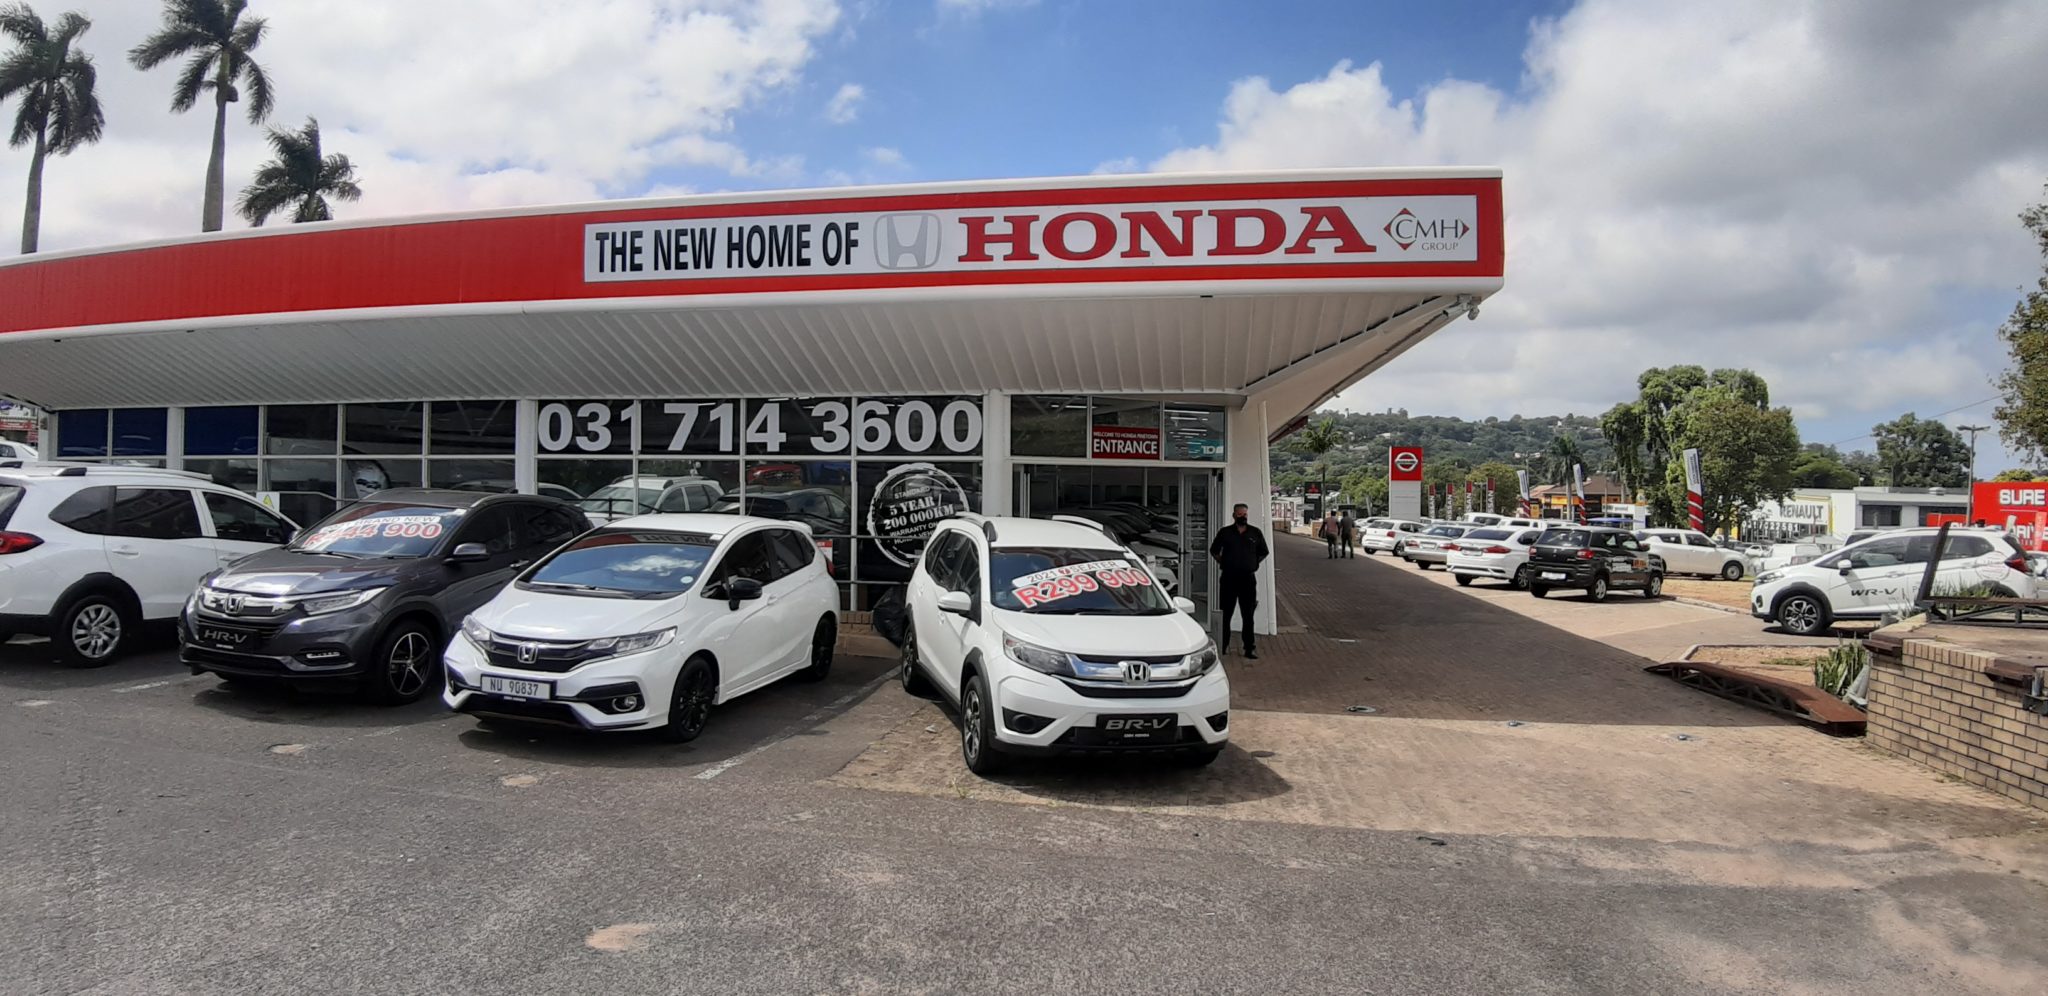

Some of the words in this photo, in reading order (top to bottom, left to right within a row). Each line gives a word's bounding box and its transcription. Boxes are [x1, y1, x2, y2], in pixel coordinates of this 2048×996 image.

[957, 206, 1377, 262] HONDA
[1396, 219, 1458, 239] CMH
[595, 230, 643, 272] THE
[653, 227, 717, 271] NEW
[726, 224, 811, 269] HOME
[822, 222, 859, 266] OF
[1421, 242, 1459, 251] GROUP
[537, 403, 642, 452] 031
[663, 403, 787, 453] 714
[809, 401, 984, 452] 3600
[1093, 438, 1158, 455] ENTRANCE
[894, 486, 931, 499] STANDARD
[2000, 489, 2046, 505] SURE
[890, 505, 898, 516] 5
[900, 496, 935, 513] YEAR
[1780, 505, 1823, 519] RENAULT
[404, 516, 436, 524] NEW
[883, 515, 907, 530] 200
[909, 504, 954, 524] 000KM
[383, 522, 442, 539] 900
[890, 524, 927, 537] WARRANTY
[1027, 570, 1058, 583] 2021
[1070, 561, 1118, 573] SEATER
[1012, 573, 1099, 608] R299
[1096, 568, 1151, 588] 900
[1851, 588, 1898, 597] WR-V
[204, 629, 247, 643] HR-V
[490, 679, 502, 692] NU
[509, 681, 539, 696] 90837
[1105, 718, 1171, 730] BR-V
